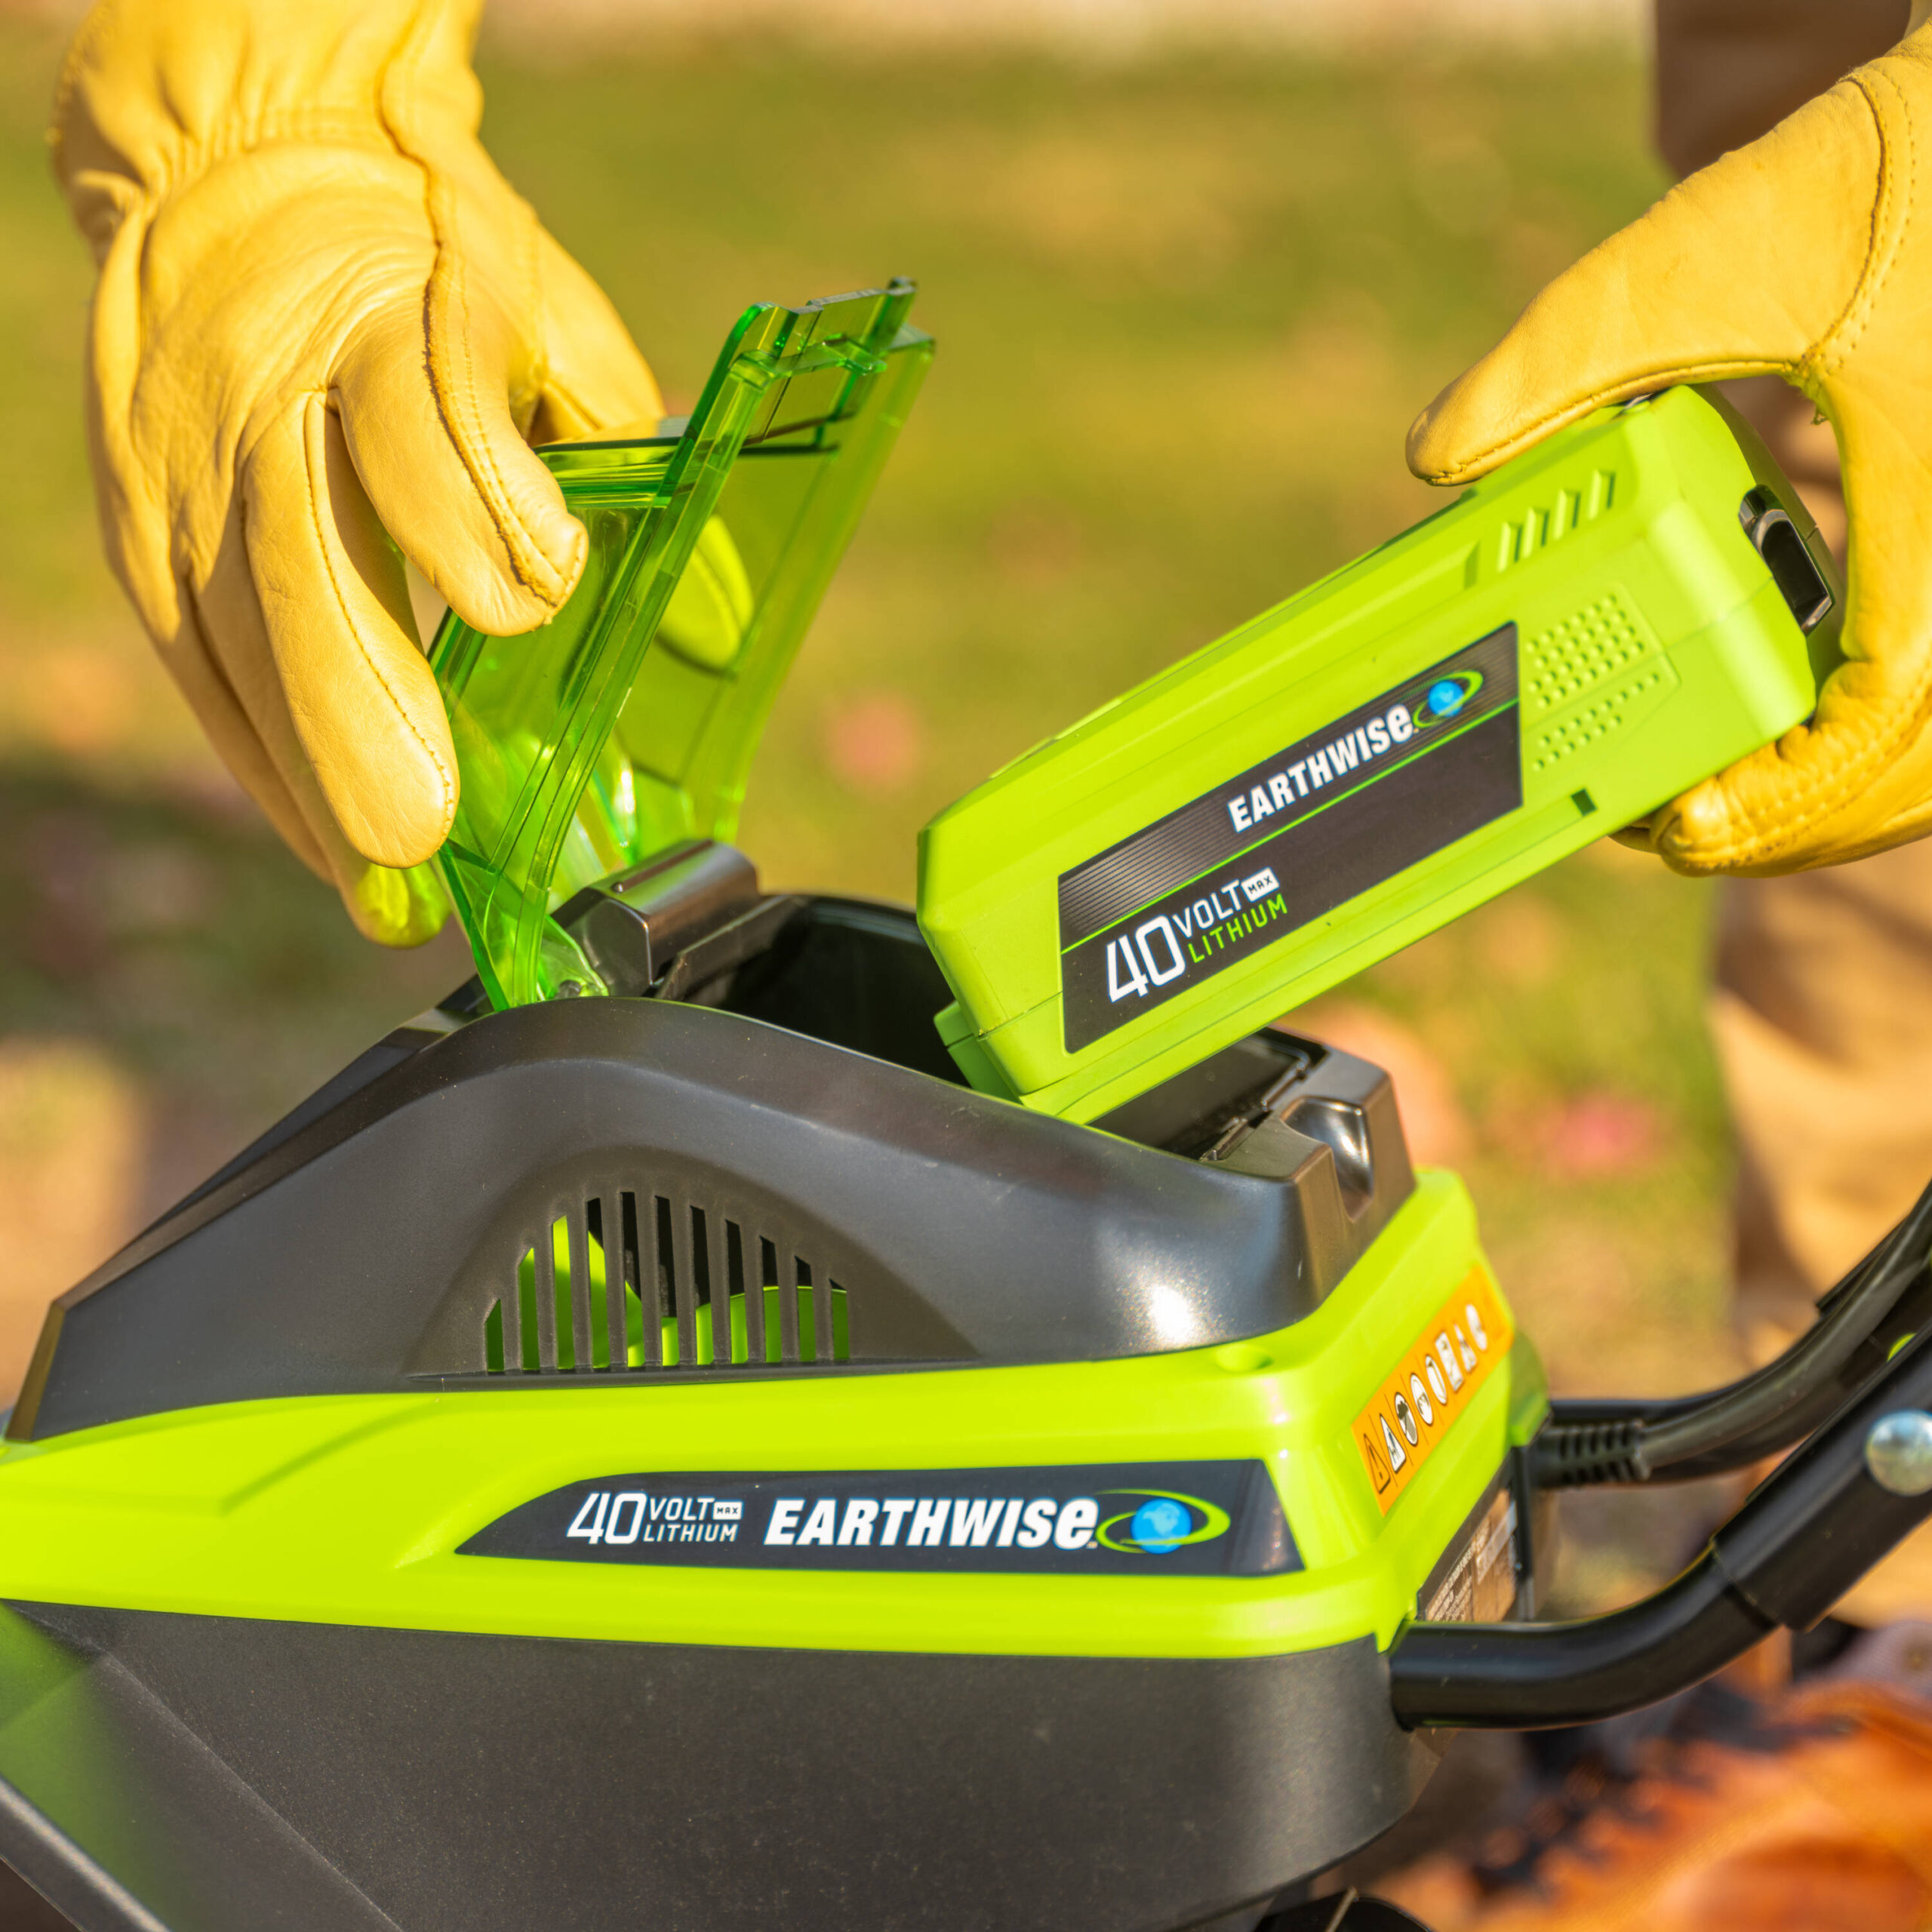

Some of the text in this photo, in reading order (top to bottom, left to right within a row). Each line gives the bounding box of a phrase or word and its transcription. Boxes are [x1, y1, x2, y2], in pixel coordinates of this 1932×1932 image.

[1106, 875, 1273, 1003] 40 VOLT MAX
[1187, 893, 1287, 963] LITHIUM
[566, 1493, 648, 1544] 40
[650, 1497, 715, 1521] VOLT
[643, 1524, 738, 1543] LITHIUM
